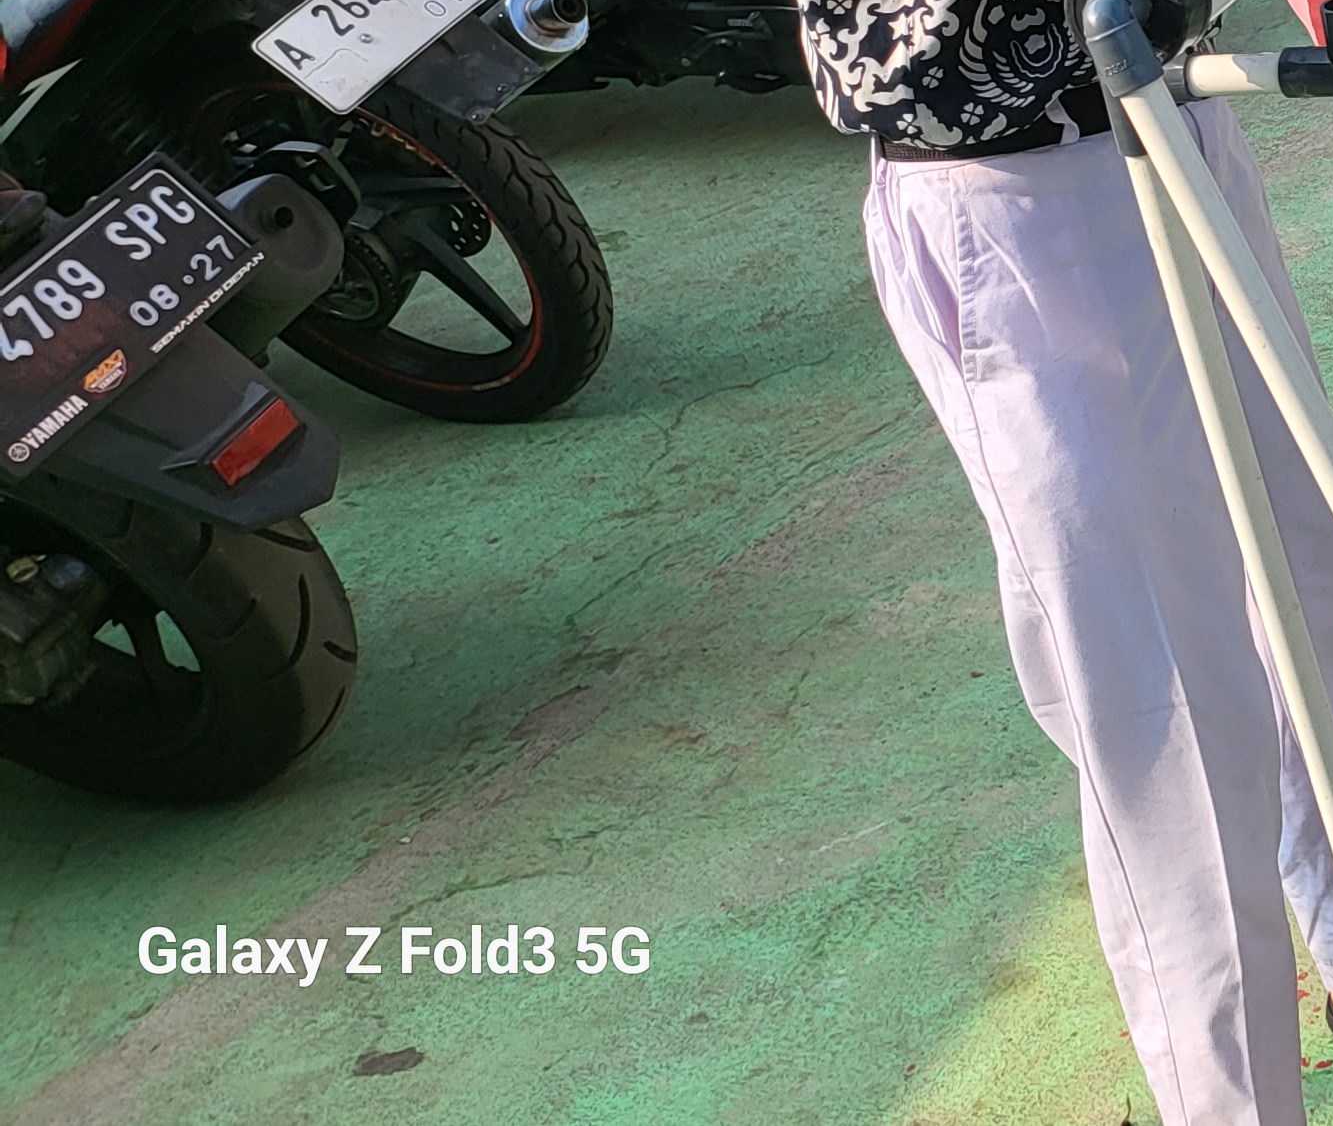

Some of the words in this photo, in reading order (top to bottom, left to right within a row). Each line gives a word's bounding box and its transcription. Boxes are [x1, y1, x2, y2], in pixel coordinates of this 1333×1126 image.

[274, 37, 316, 72] A
[105, 185, 196, 261] SPG
[149, 300, 211, 354] SEMAKIN
[222, 252, 265, 292] DEPAN
[20, 394, 89, 450] YAMAHA
